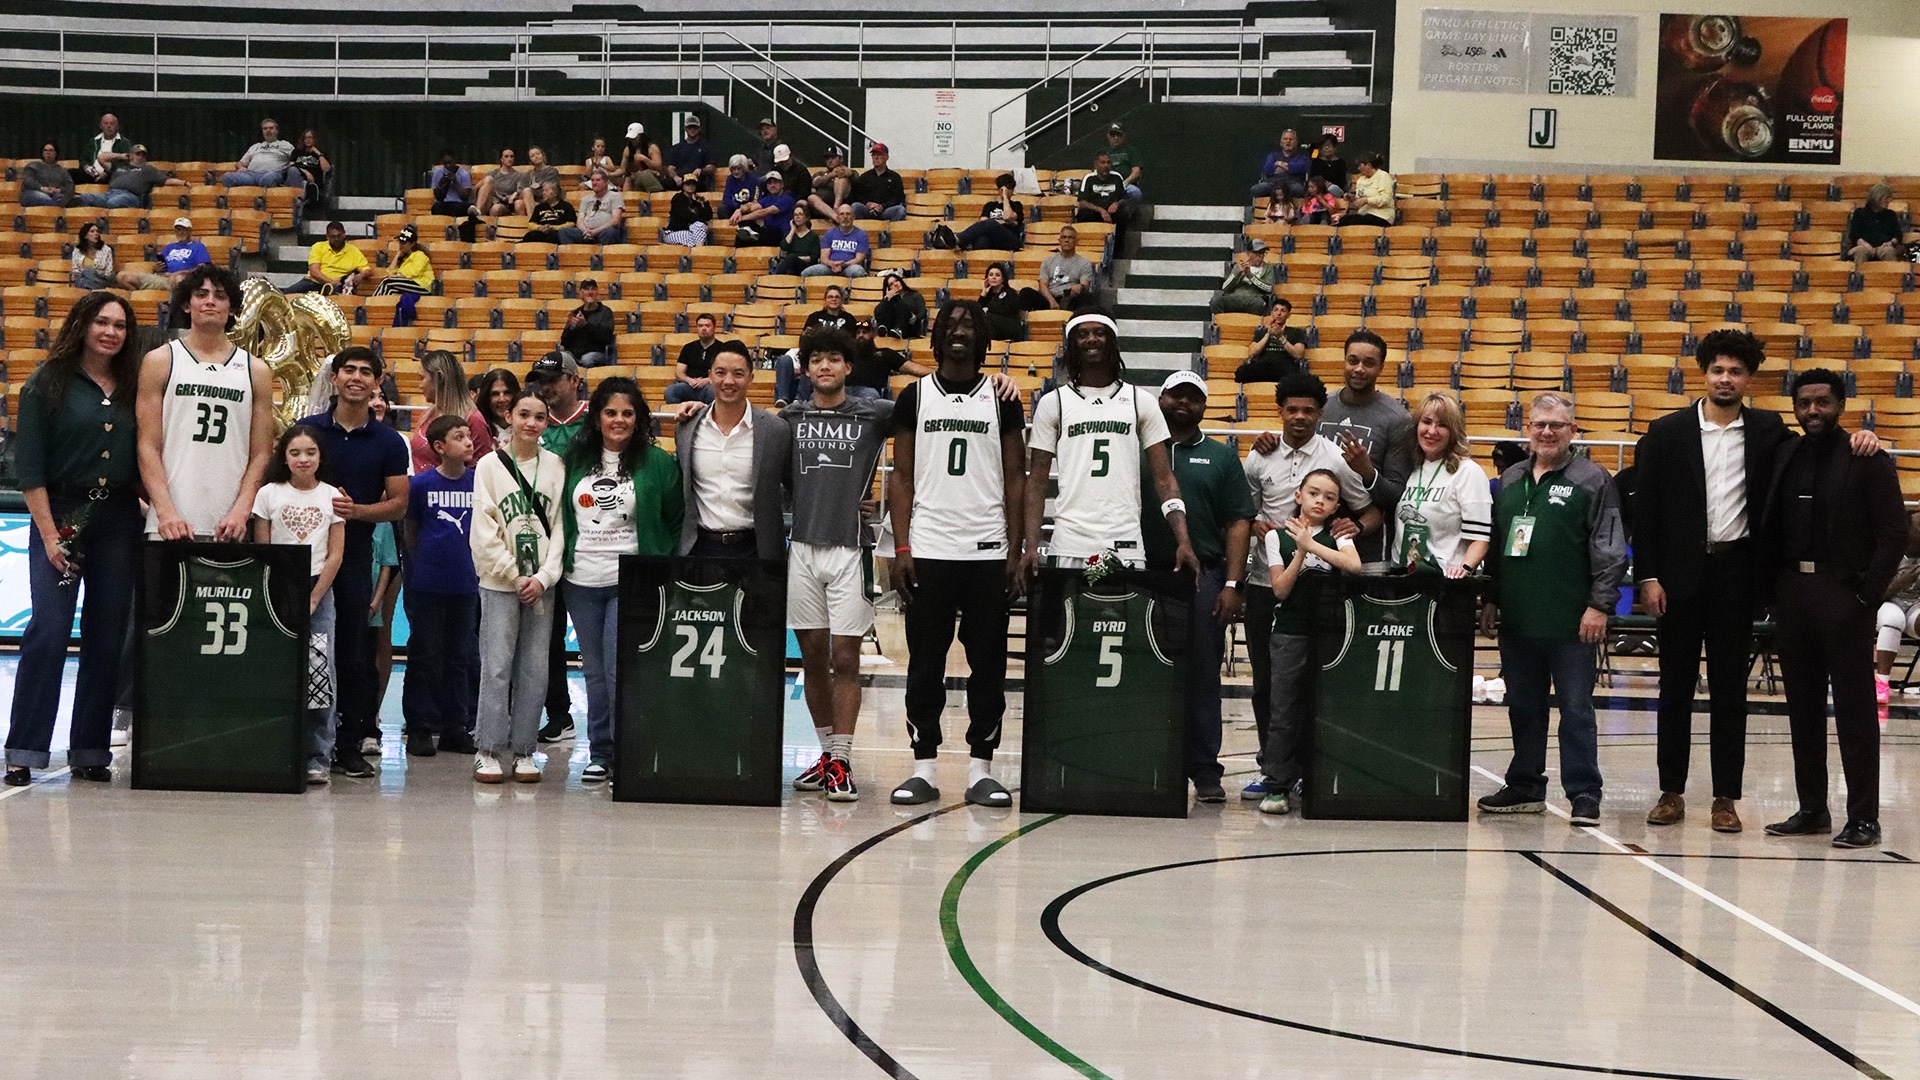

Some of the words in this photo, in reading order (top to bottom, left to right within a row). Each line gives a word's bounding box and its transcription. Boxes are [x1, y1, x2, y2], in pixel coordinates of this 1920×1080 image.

[1462, 20, 1527, 30] ATHLETICS
[1425, 31, 1461, 40] GAME
[1464, 32, 1486, 41] DAY
[1488, 33, 1524, 42] LINKS
[1448, 62, 1499, 72] ROSTERS
[1424, 73, 1482, 84] PREGAME
[1484, 75, 1522, 86] NOTES
[937, 122, 952, 131] NO
[1535, 110, 1551, 145] J
[1789, 139, 1834, 150] ENMU
[175, 383, 245, 403] GREYHOUNDS
[192, 402, 228, 444] 33
[796, 422, 862, 440] ENMU
[924, 418, 991, 434] GREYHOUNDS
[1068, 420, 1132, 437] GREYHOUNDS
[799, 441, 855, 451] HOUNDS
[948, 437, 967, 476] 0
[1091, 439, 1110, 477] 5
[1402, 486, 1446, 502] NMU
[1549, 485, 1573, 496] ENMU
[427, 491, 474, 508] PUMA
[196, 586, 252, 599] MURILLO
[671, 610, 726, 622] JACKSON
[200, 602, 248, 655] 33
[1092, 621, 1127, 632] BYRD
[1367, 624, 1414, 636] CLARKE
[670, 624, 727, 678] 24
[1096, 635, 1123, 687] 5
[1374, 640, 1405, 691] 11
